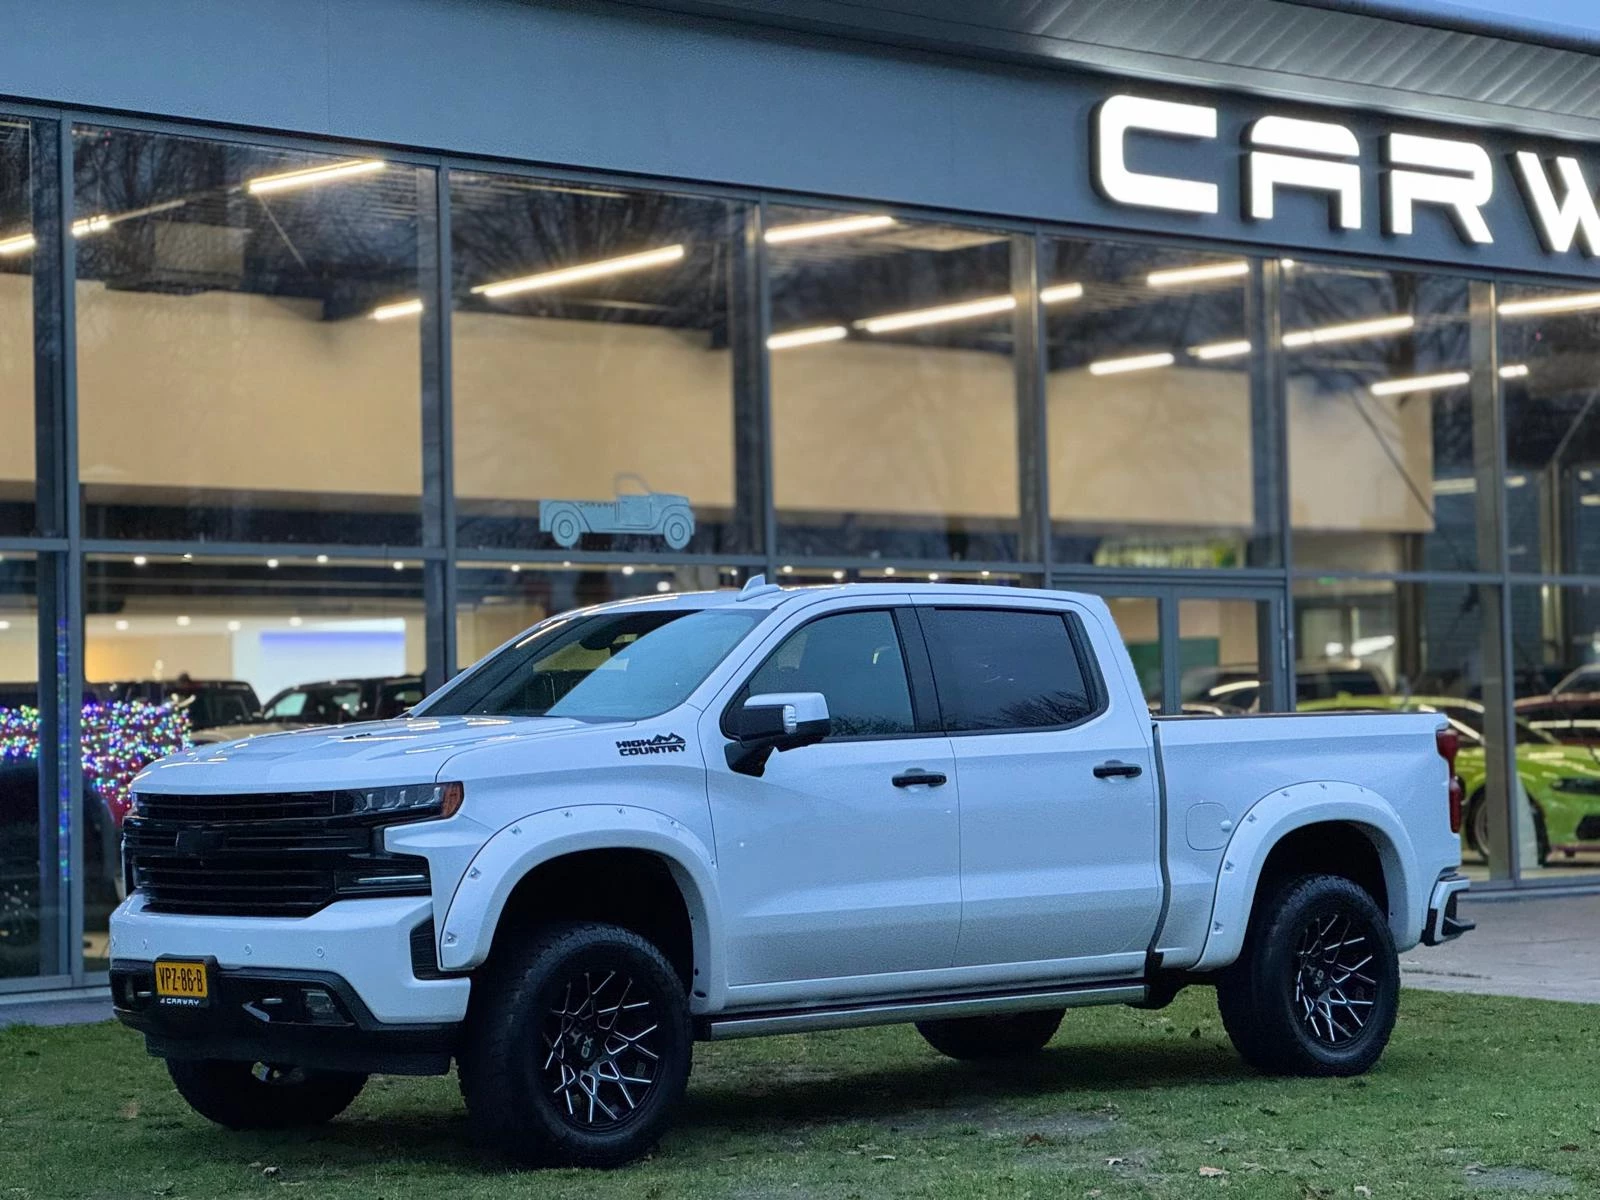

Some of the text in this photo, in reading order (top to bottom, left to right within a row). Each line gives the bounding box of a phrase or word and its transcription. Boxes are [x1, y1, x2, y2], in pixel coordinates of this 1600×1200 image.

[1094, 94, 1600, 257] CARW
[615, 739, 653, 749] HIGH
[619, 744, 686, 756] COUNTRY
[158, 967, 203, 992] VPZ-86-B
[166, 997, 200, 1006] CARWAY
